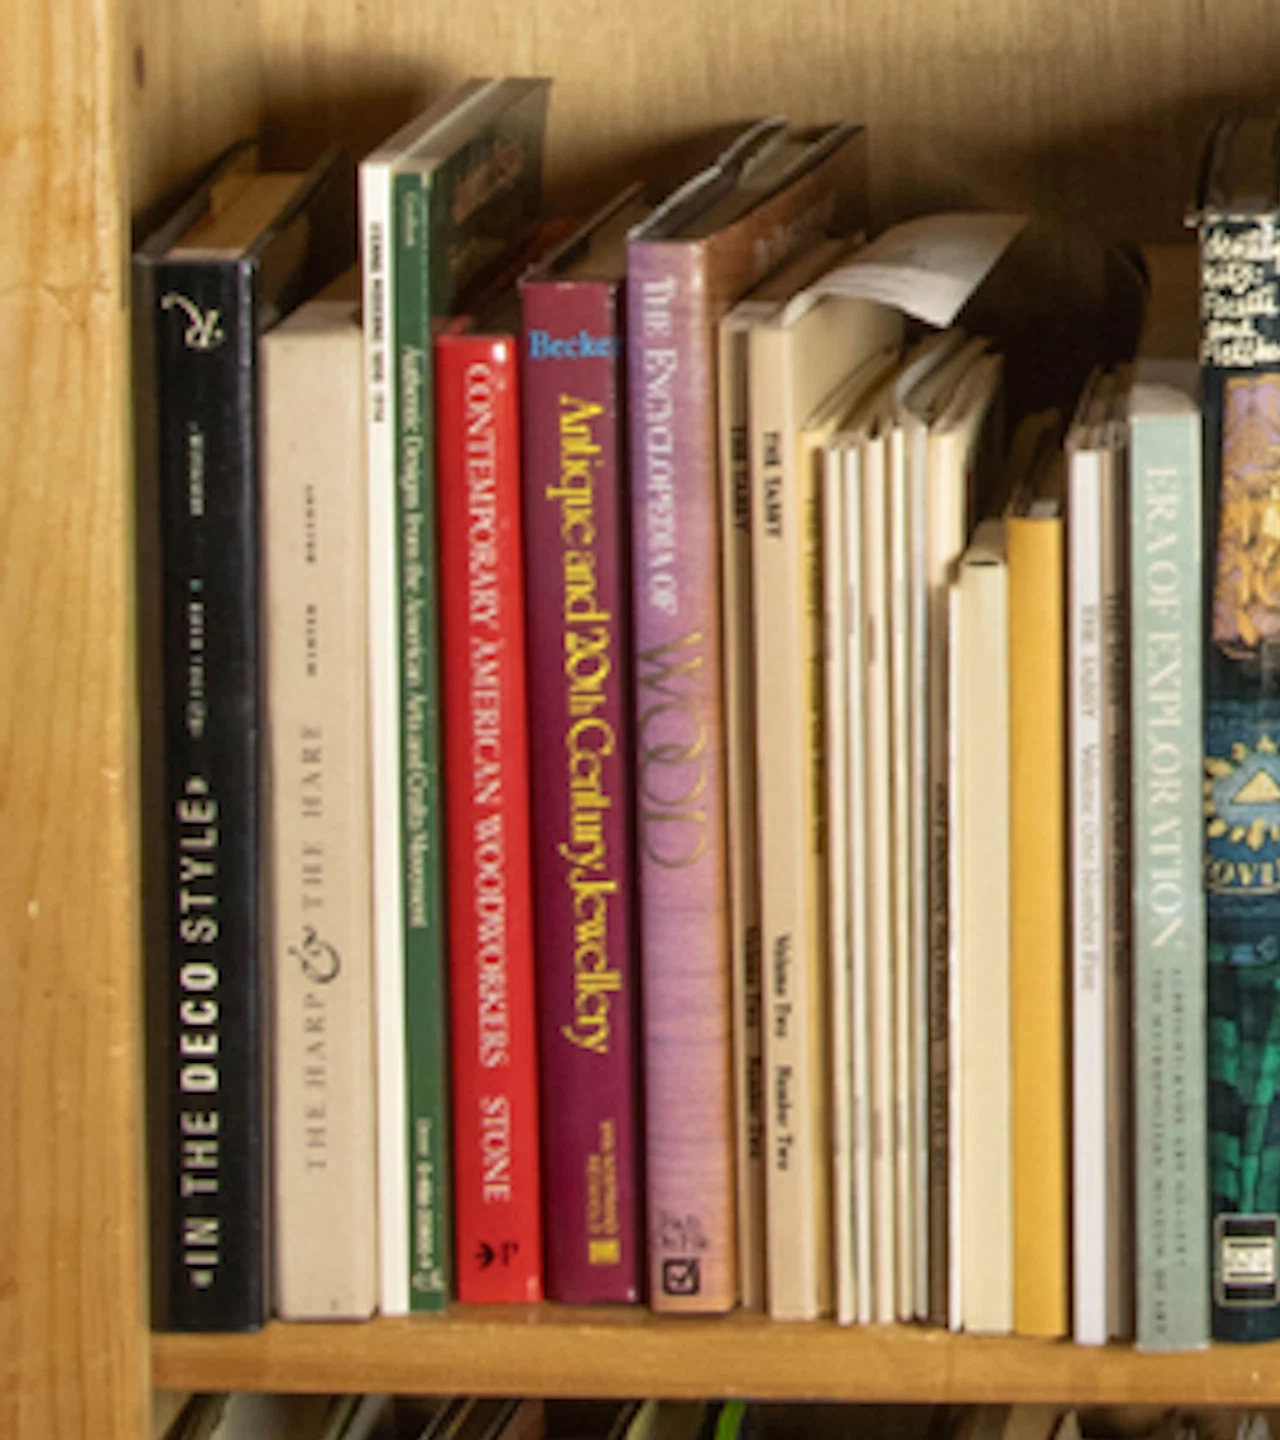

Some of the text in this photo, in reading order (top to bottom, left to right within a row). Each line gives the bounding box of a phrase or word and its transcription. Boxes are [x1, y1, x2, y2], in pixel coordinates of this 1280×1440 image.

[464, 364, 511, 1202] CONTEMPORARY AMERICAN WOODWORKERS STONE
[549, 396, 614, 1053] Antique and 20th Century Jewellery
[1143, 465, 1184, 950] ERA OF EXPLORATION
